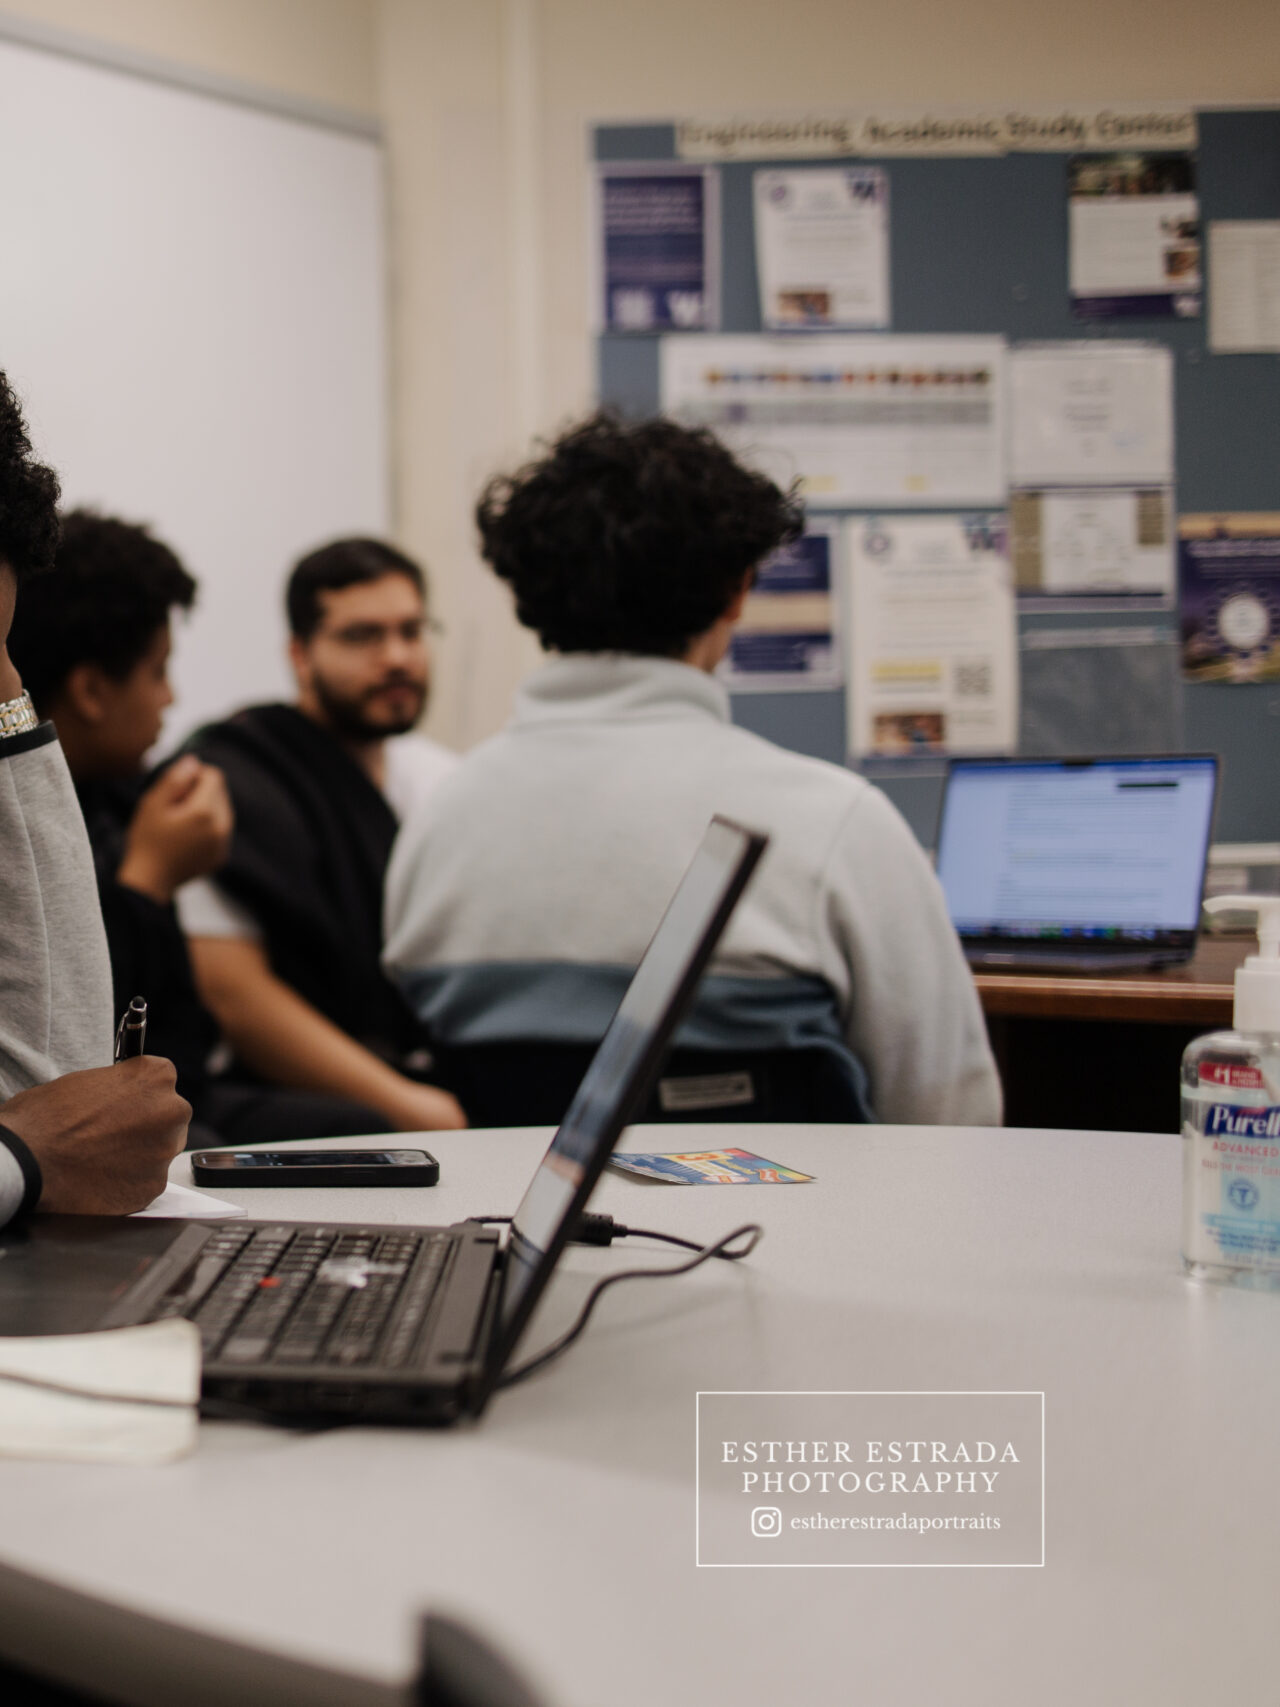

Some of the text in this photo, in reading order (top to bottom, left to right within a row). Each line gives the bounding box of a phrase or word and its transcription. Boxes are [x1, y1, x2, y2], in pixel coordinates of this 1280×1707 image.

[862, 112, 999, 143] Academic
[1006, 111, 1084, 145] Study
[1213, 1141, 1279, 1158] ADVANCED
